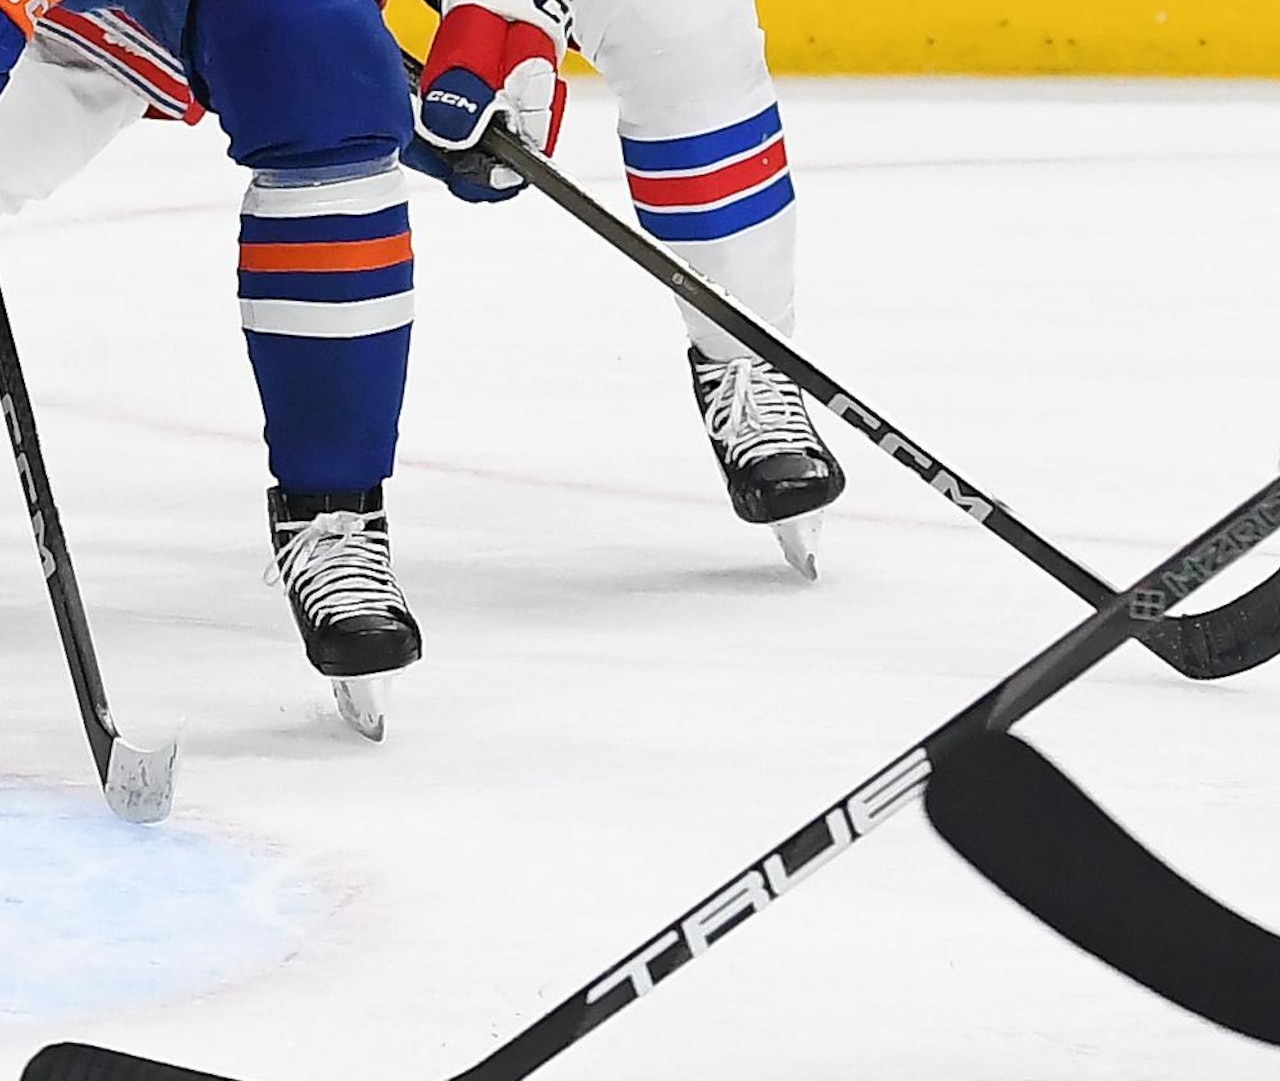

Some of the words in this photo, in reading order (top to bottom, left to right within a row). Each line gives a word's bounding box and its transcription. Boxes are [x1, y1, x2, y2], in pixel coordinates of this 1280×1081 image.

[426, 90, 478, 114] CCM
[826, 392, 994, 523] CCM
[585, 746, 934, 999] TRUE
